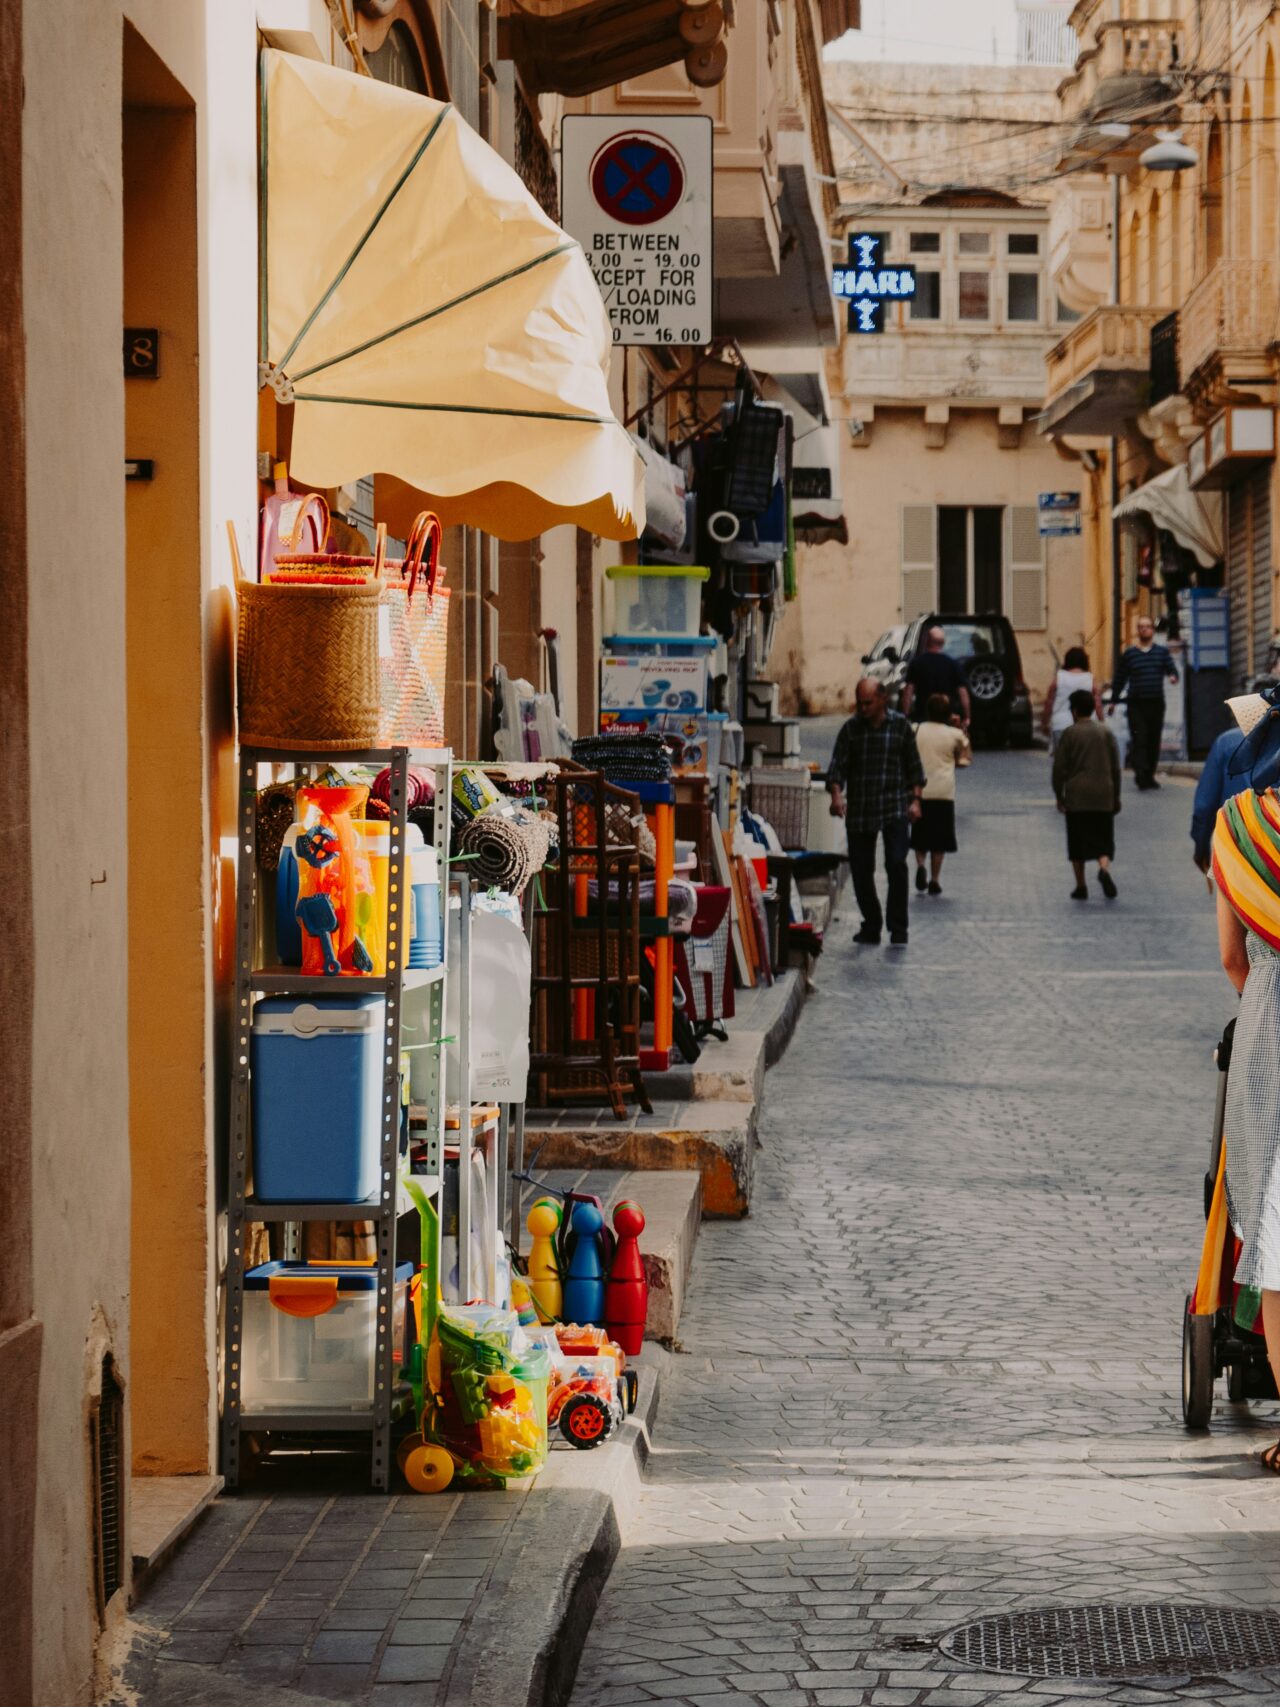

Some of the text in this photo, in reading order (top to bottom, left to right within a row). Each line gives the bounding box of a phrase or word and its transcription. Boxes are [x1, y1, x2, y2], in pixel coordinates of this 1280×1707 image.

[593, 234, 680, 251] BETWEEN
[655, 253, 700, 268] 19.00
[592, 269, 695, 286] XCEPT FOR
[600, 286, 696, 306] /LOADING
[609, 308, 659, 325] FROM
[655, 328, 700, 342] 16.00
[606, 723, 640, 732] vileda
